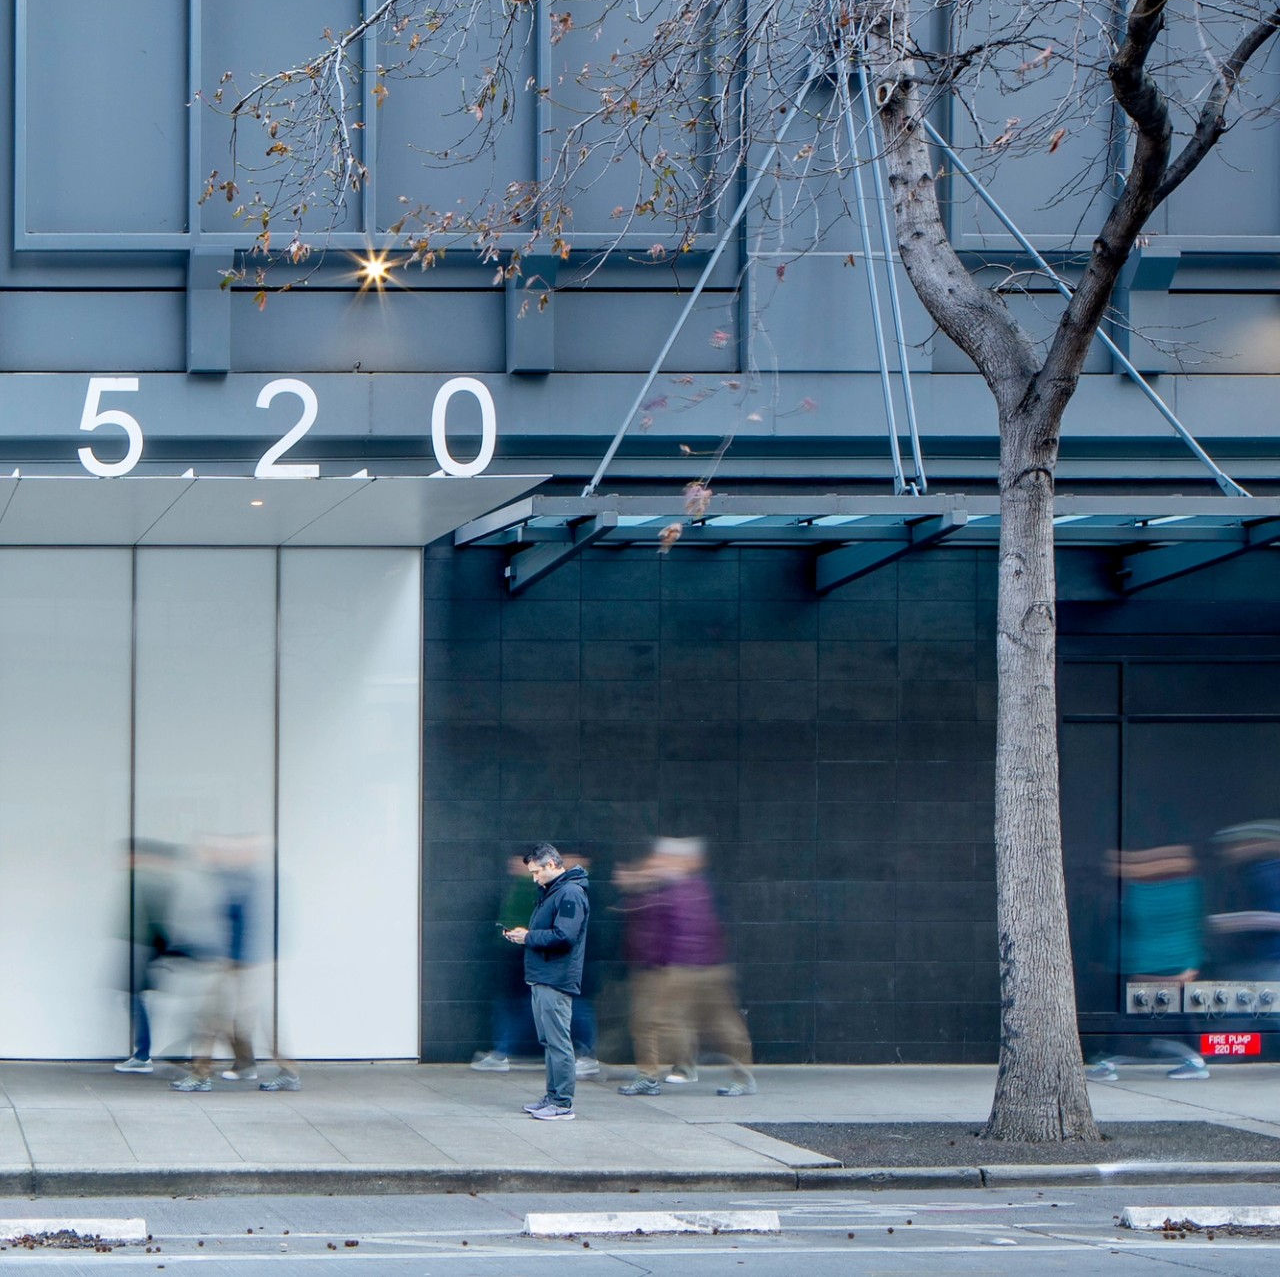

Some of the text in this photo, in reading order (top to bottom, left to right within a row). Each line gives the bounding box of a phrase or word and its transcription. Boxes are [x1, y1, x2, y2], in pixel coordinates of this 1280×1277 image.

[77, 376, 497, 478] 520
[1208, 1034, 1251, 1044] FIRE PUMP
[1214, 1044, 1246, 1054] 220 PSI
